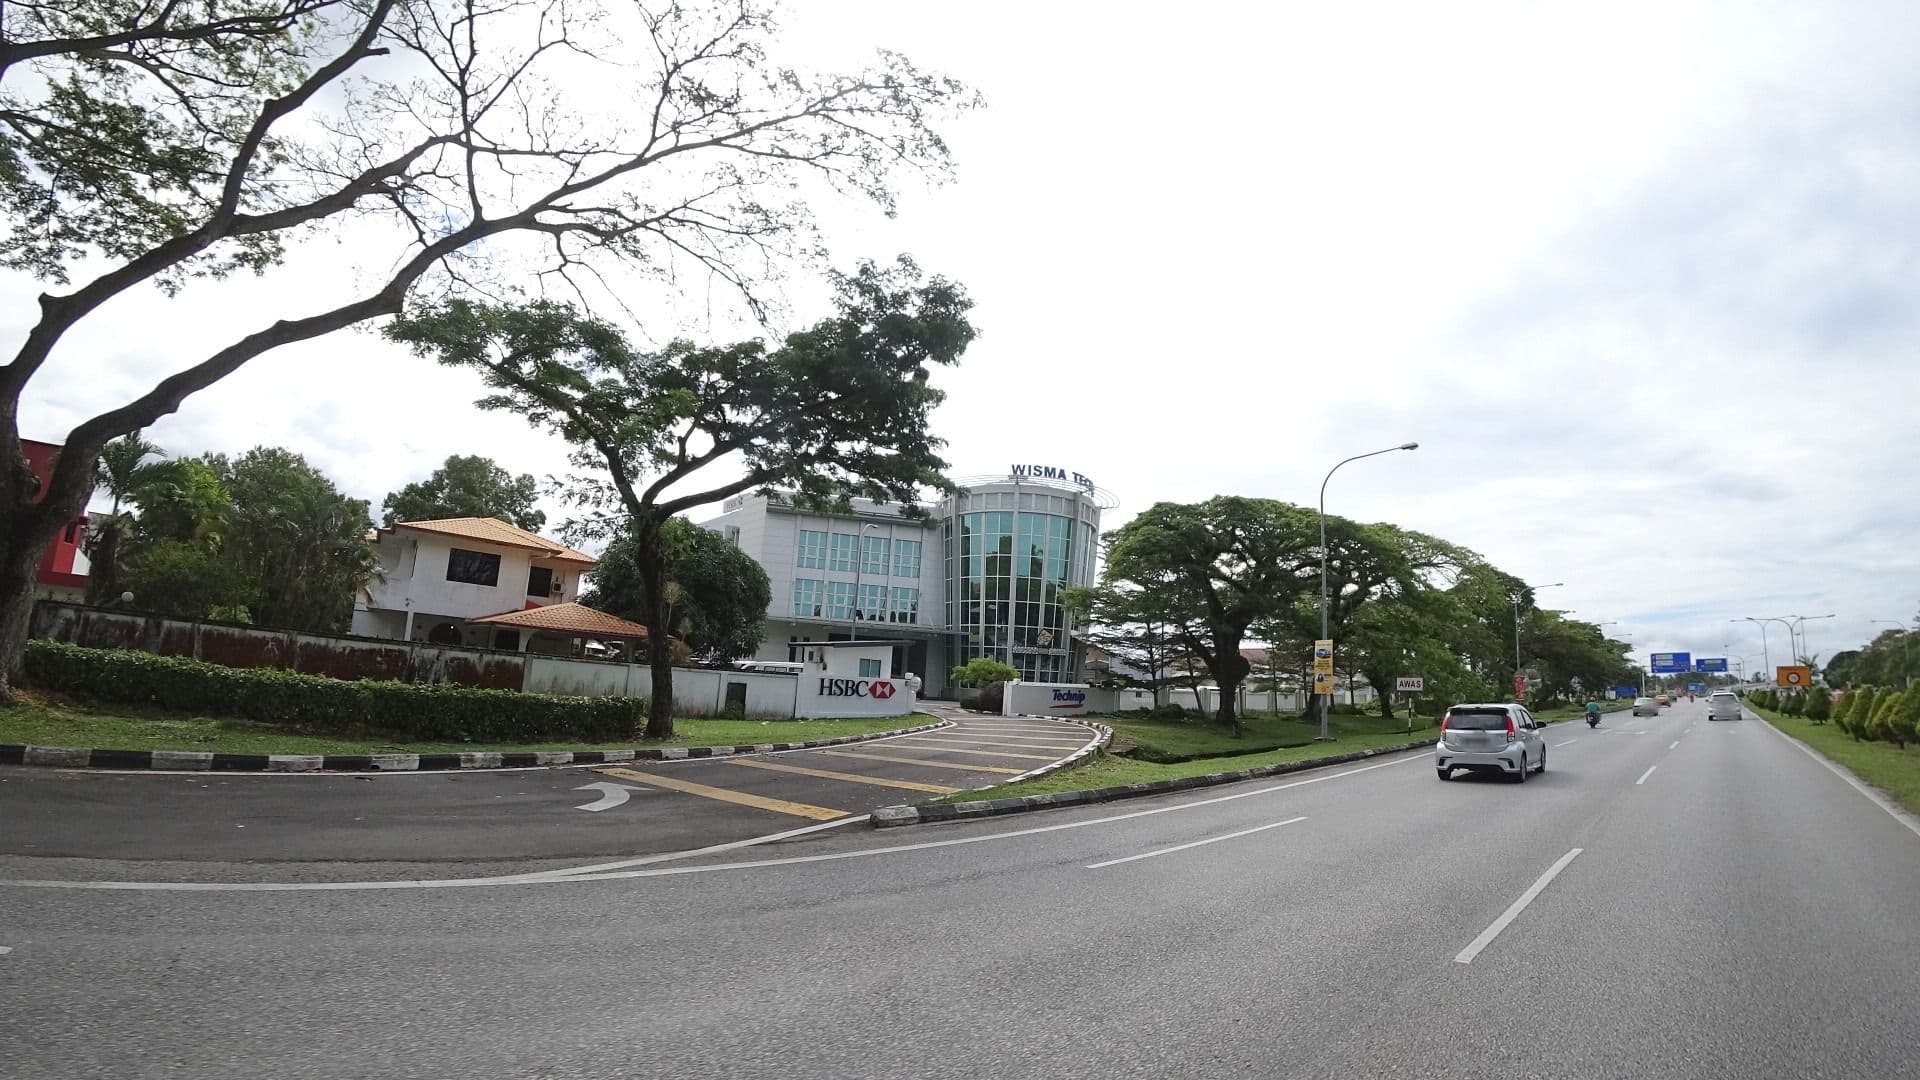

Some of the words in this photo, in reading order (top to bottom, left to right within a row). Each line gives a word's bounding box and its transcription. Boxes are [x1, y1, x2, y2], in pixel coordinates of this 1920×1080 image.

[1012, 464, 1067, 480] WISMA
[818, 678, 869, 697] HSBC
[1399, 680, 1421, 689] AWAS
[1052, 689, 1086, 704] Technip
